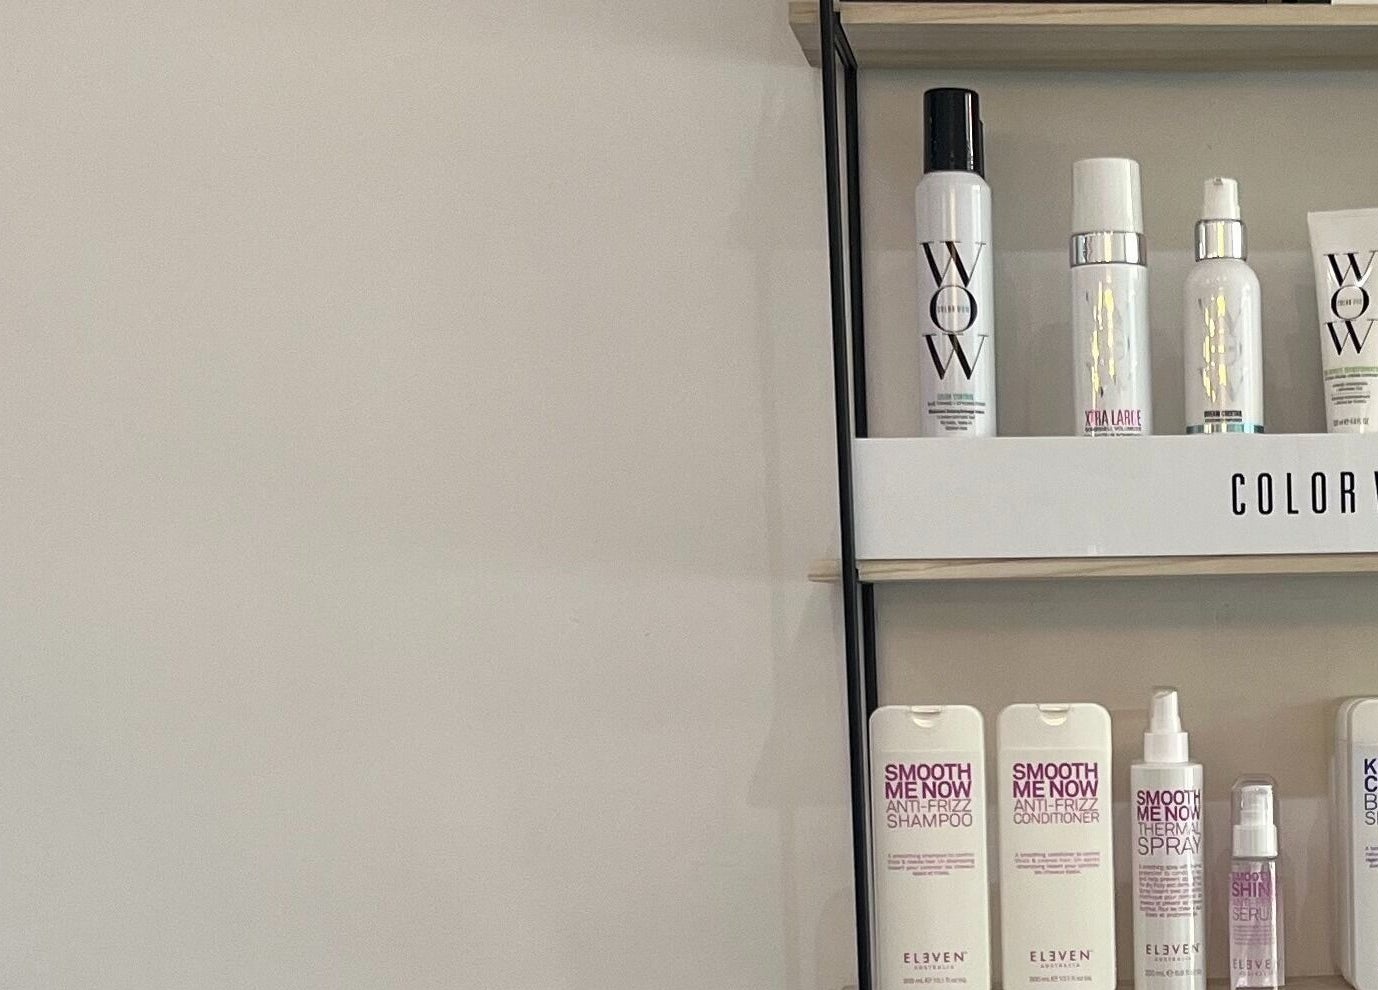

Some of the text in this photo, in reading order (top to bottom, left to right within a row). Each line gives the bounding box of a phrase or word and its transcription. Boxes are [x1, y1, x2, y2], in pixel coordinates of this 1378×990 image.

[1231, 471, 1356, 516] COLOR
[884, 763, 972, 781] SMOOTH
[1012, 762, 1098, 780] SMOOTH
[885, 780, 972, 799] ME NOW
[1012, 780, 1098, 798] ME NOW
[1136, 789, 1200, 806] SMOOTH
[886, 799, 972, 813] ANTI-FRIZZ
[1013, 798, 1099, 812] ANTI-FRIZZ
[1136, 805, 1200, 821] ME NOW
[887, 813, 973, 829] SHAMPOO
[1013, 811, 1100, 825] CONDITIONER
[1138, 821, 1202, 837] THERMAL
[1138, 836, 1201, 856] SPRAY
